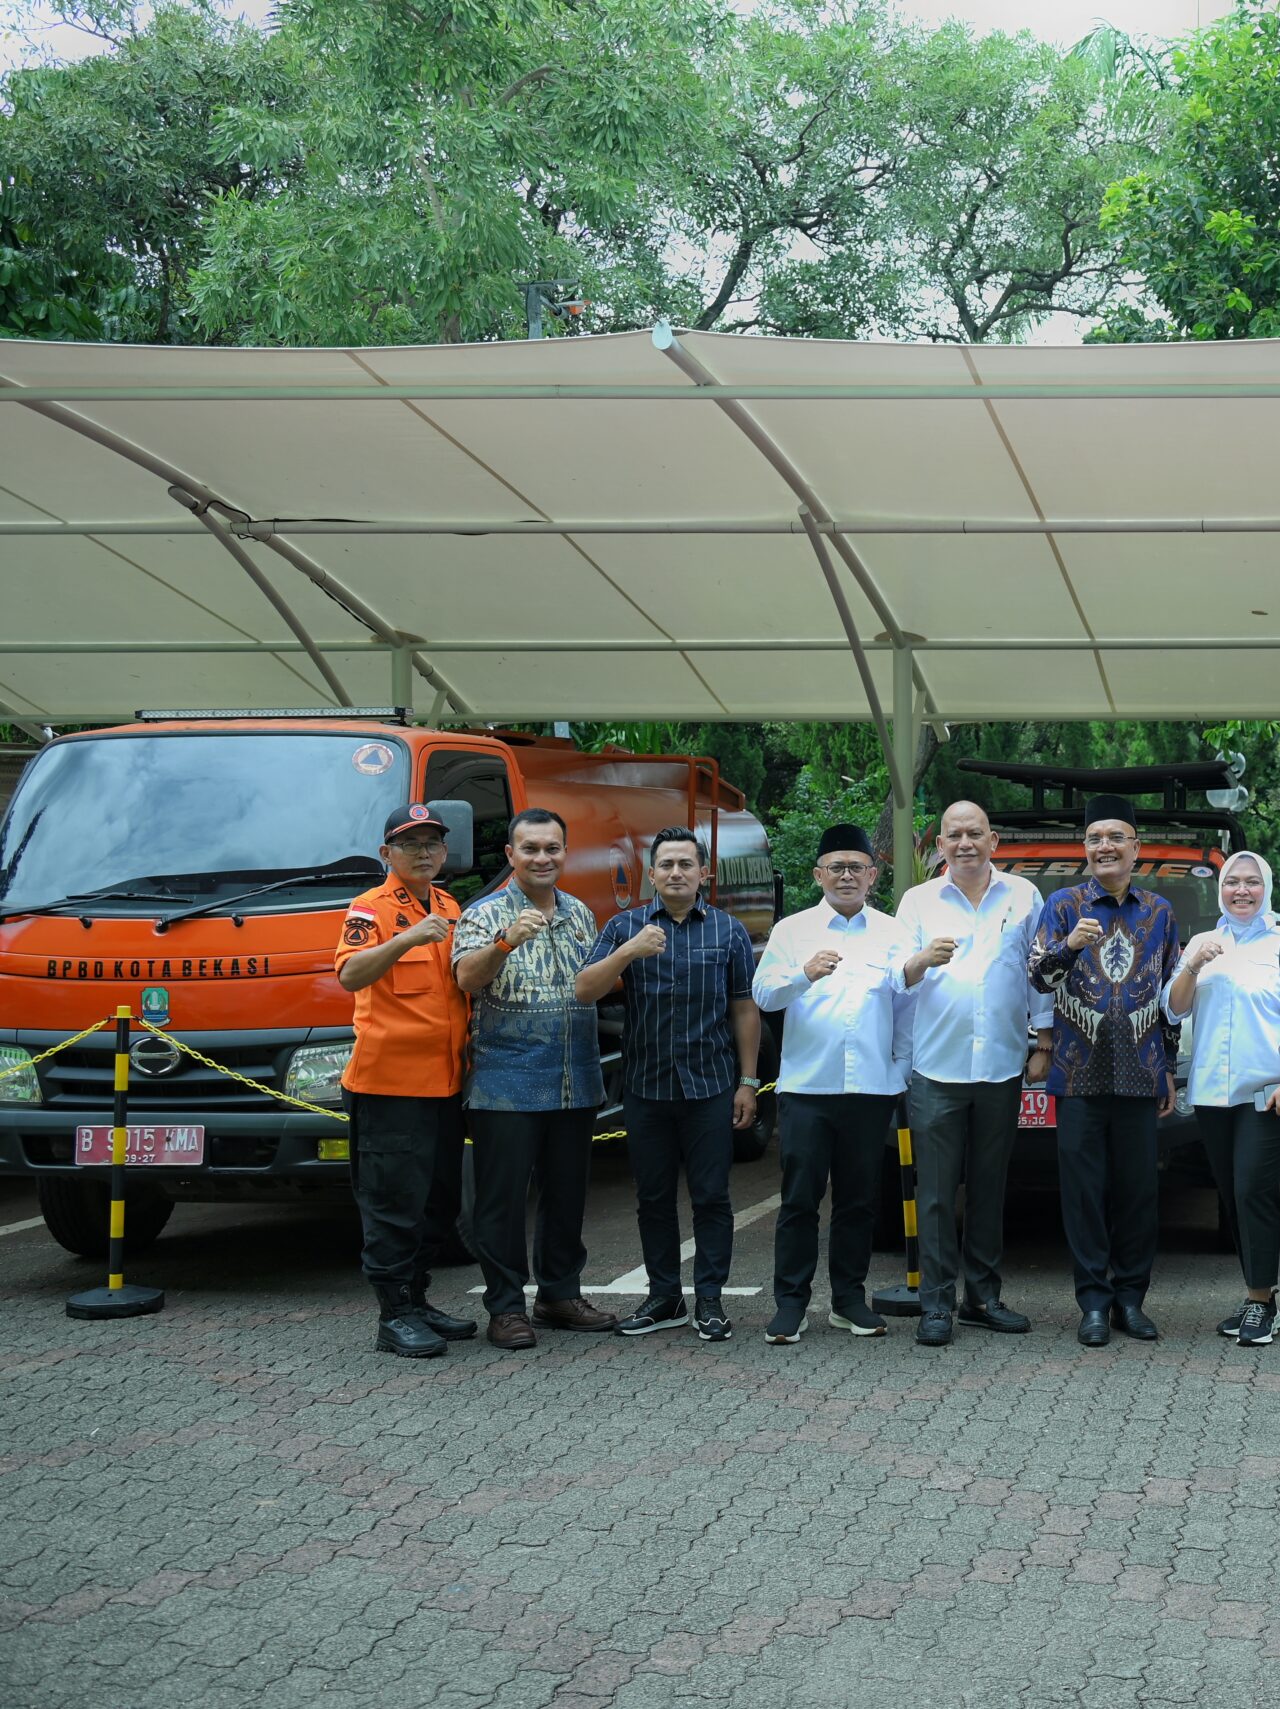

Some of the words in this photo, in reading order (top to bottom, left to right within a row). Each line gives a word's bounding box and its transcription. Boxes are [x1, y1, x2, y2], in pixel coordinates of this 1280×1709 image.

[47, 959, 104, 978] BPBD
[114, 960, 171, 978] KOTA
[182, 957, 269, 977] BEKASI
[1019, 1093, 1048, 1115] 19
[81, 1128, 93, 1152] B
[164, 1128, 199, 1152] KMA
